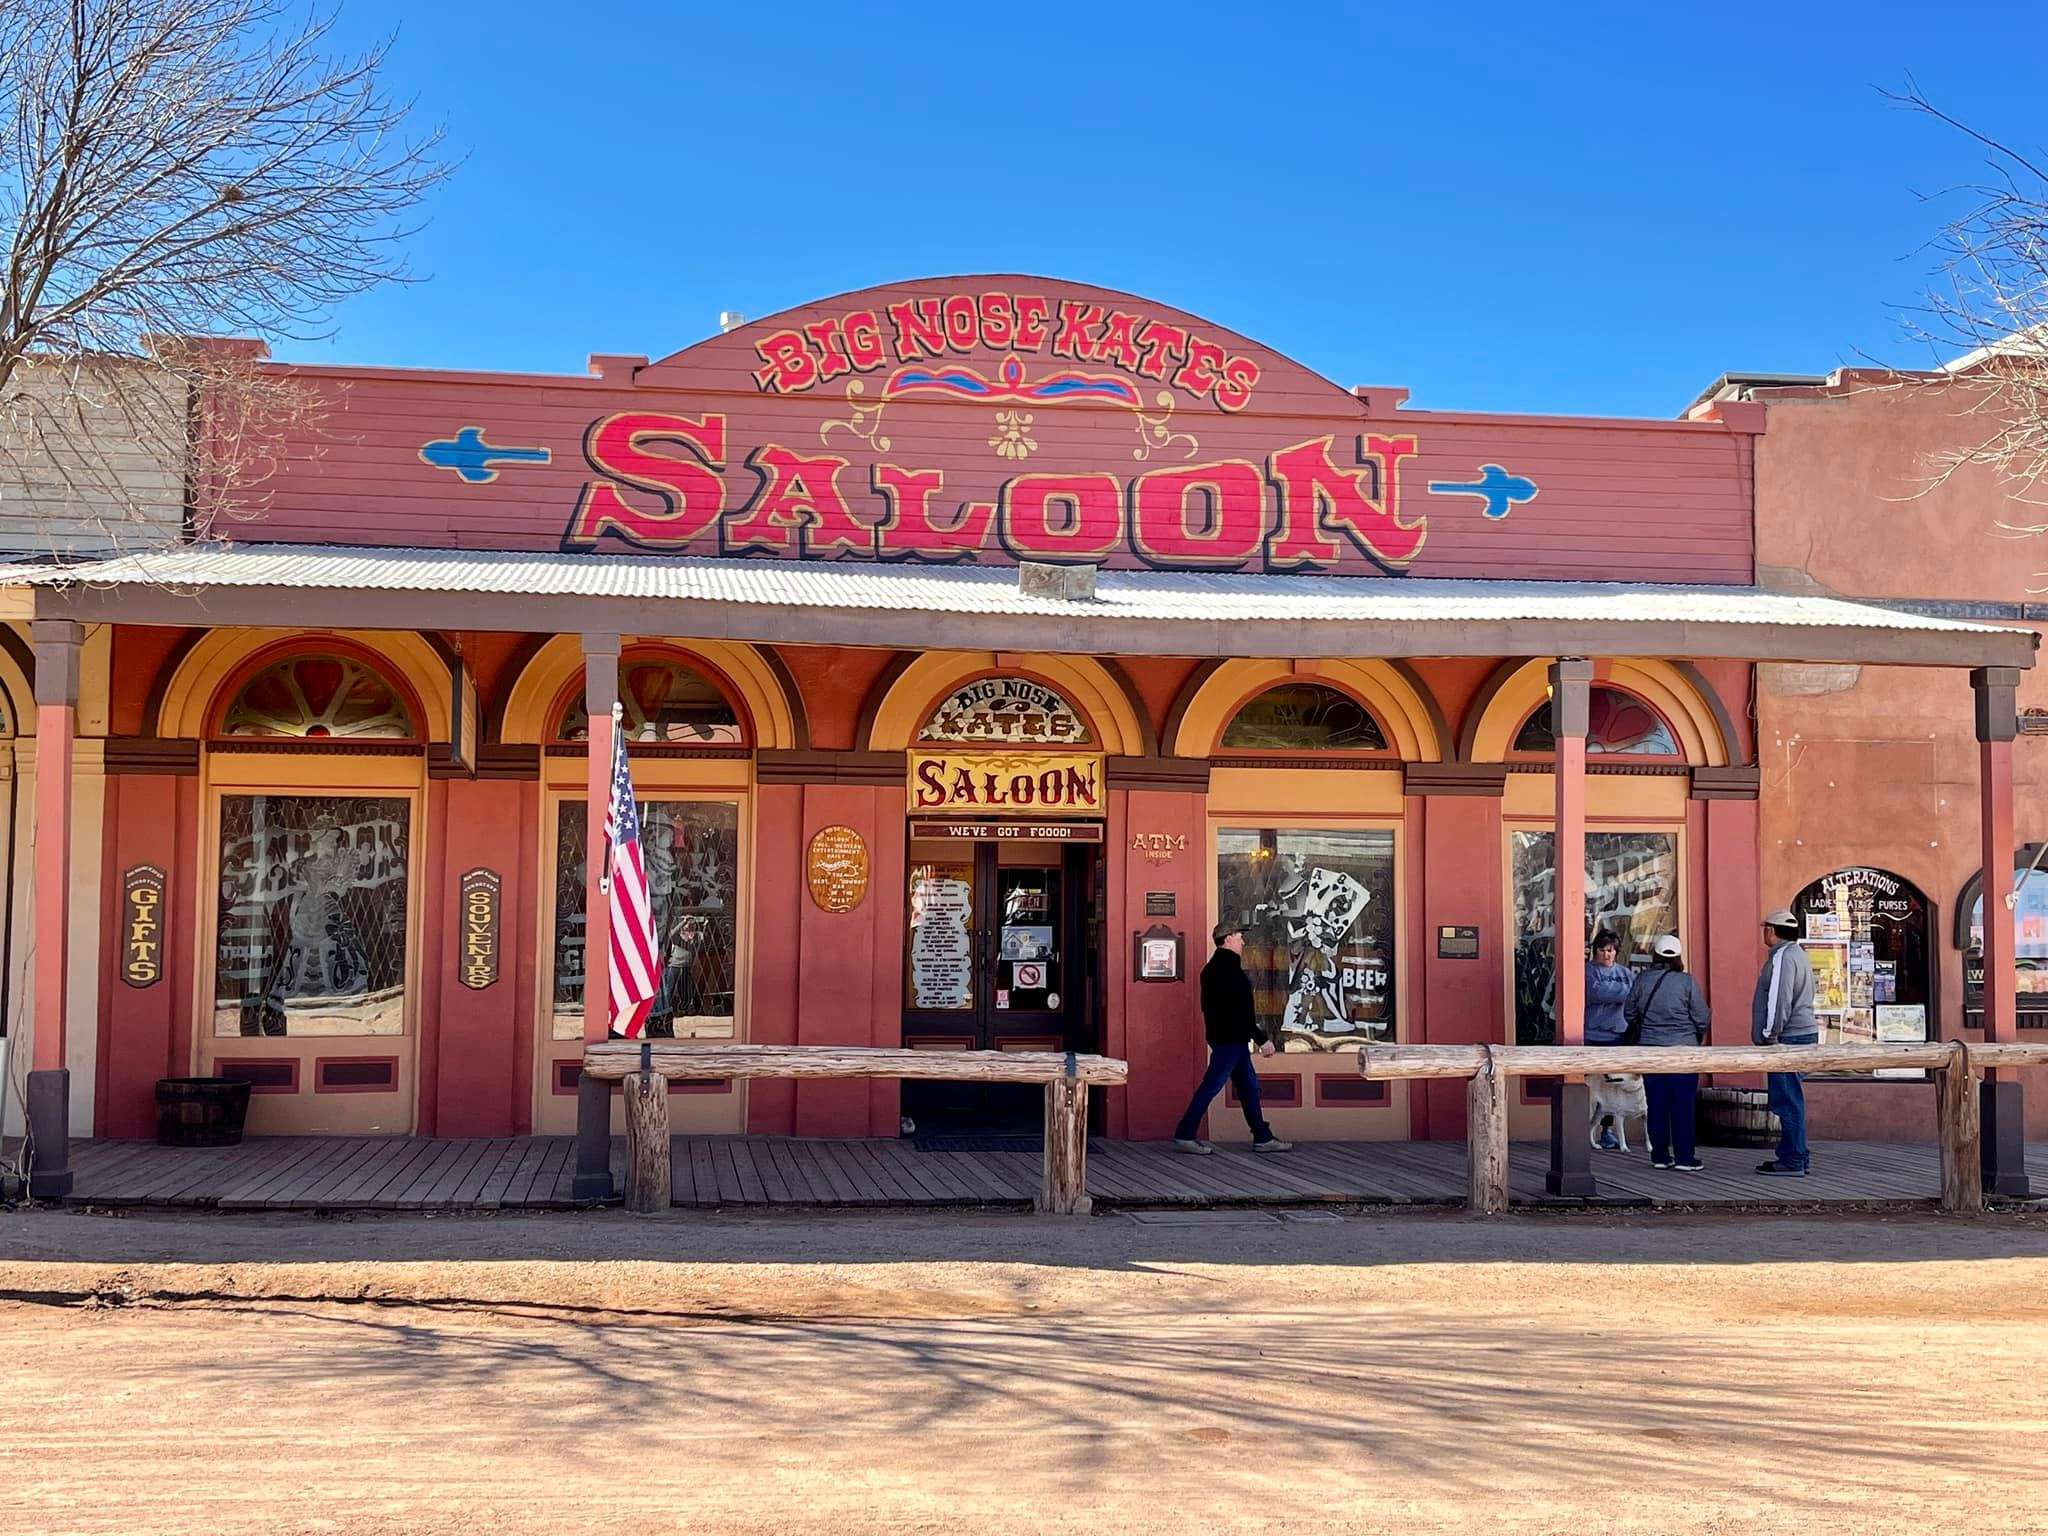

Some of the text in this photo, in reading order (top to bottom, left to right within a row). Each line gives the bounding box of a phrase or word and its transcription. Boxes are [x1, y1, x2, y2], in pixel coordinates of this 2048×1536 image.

[754, 311, 886, 393] BIG
[888, 292, 1049, 361] NOSE
[564, 412, 1429, 574] SALOON
[955, 680, 1061, 712] BIG NOSE
[917, 760, 1097, 807] SALOON
[949, 826, 1072, 838] WE'VE GOT FOOOD!
[1133, 833, 1185, 850] ATM
[1145, 850, 1173, 859] INSIDE
[1821, 870, 1900, 896] ALTERATIONS
[1878, 900, 1908, 910] PURSES
[128, 888, 158, 981] GIFTS
[467, 892, 492, 988] SOUVENIRS
[1342, 967, 1388, 990] BEER
